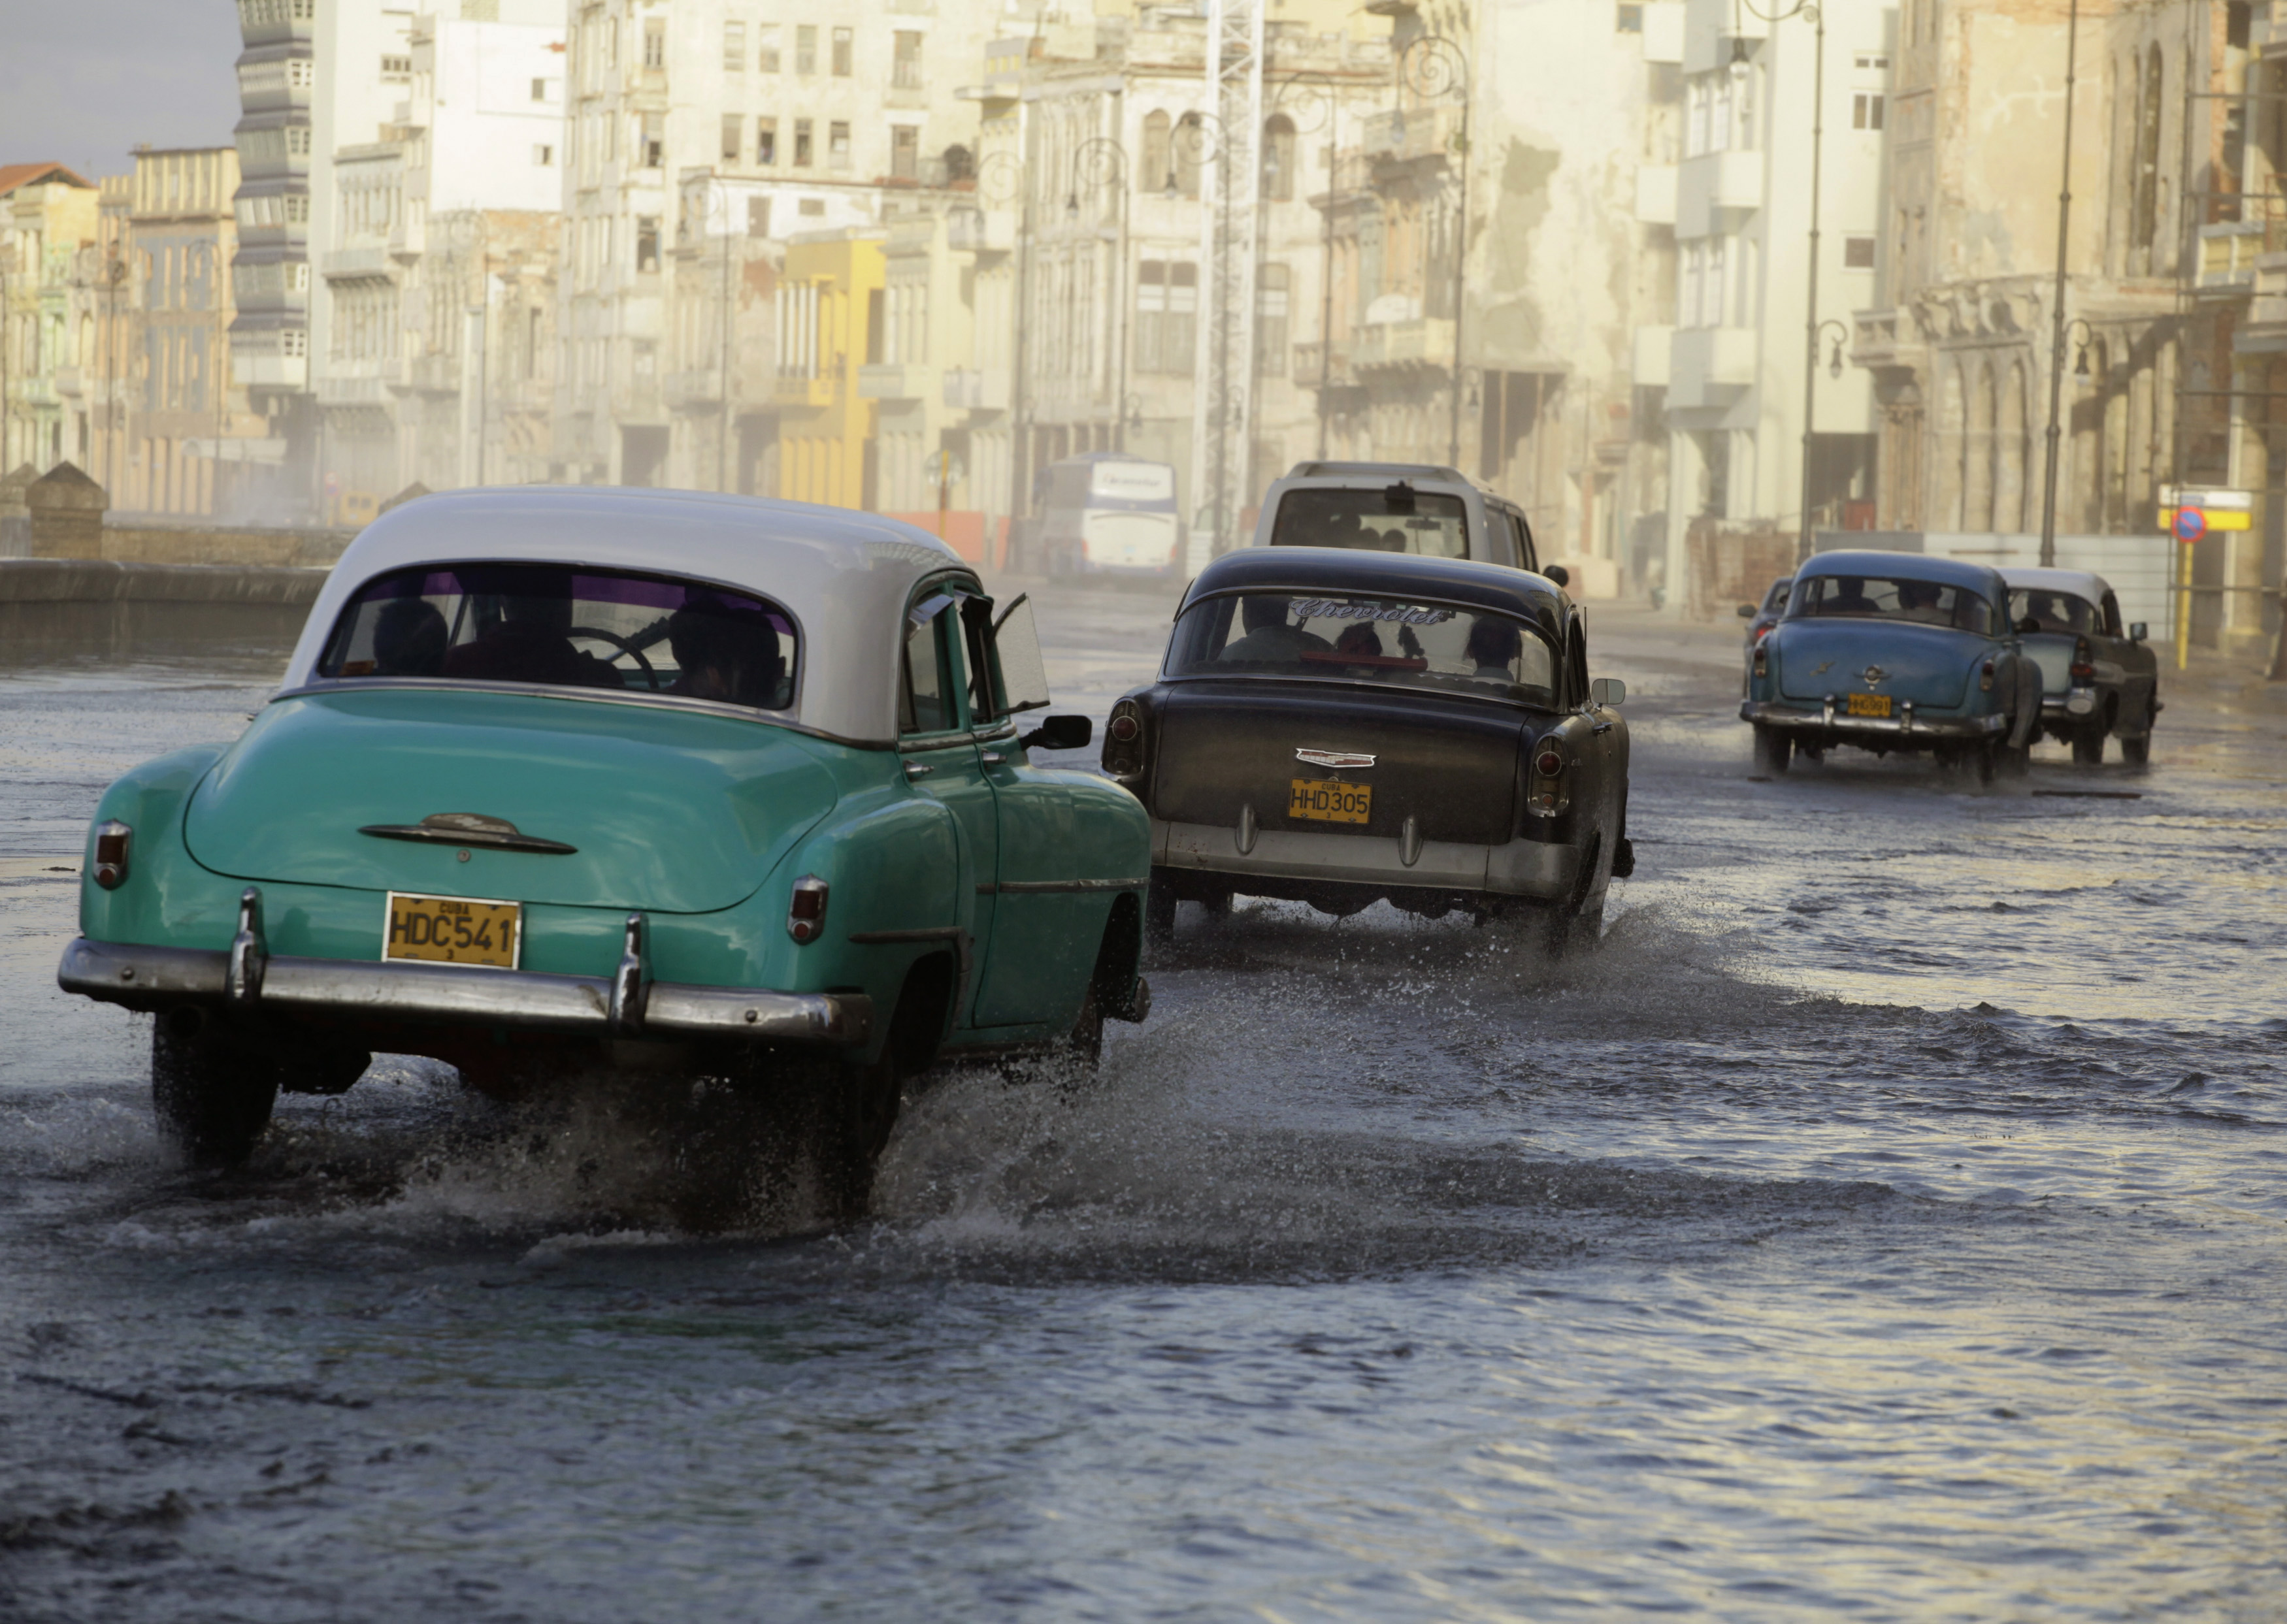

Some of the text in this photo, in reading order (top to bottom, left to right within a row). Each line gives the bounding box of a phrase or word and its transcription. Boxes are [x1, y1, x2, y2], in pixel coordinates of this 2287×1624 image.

[1290, 598, 1443, 625] Chevrolet
[1291, 788, 1368, 814] HHD305
[439, 903, 470, 915] CUBA
[390, 911, 510, 952] HDC541
[446, 949, 453, 959] 3
